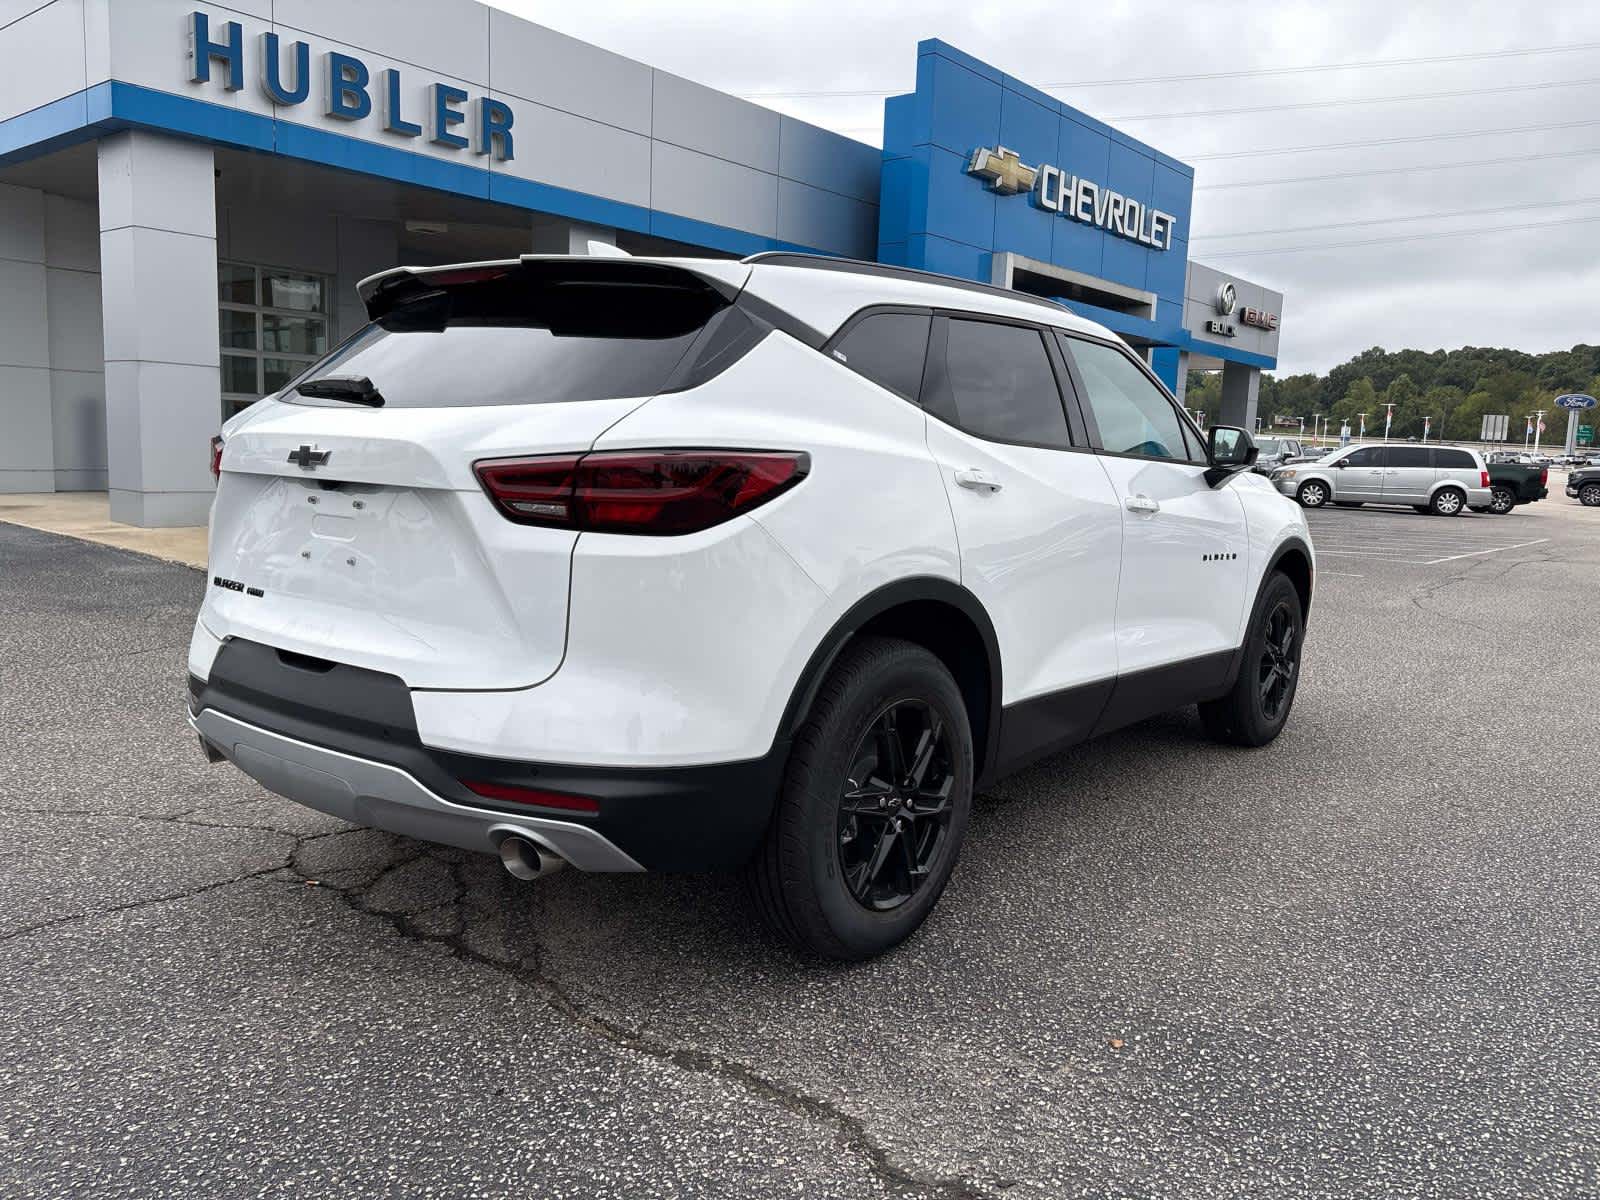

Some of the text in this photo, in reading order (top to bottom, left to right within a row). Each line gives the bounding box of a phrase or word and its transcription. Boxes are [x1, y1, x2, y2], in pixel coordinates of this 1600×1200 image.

[190, 11, 515, 162] HUBLER
[1038, 164, 1177, 250] CHEVROLET
[1209, 319, 1239, 337] BUICK
[1242, 306, 1278, 331] GMC
[1563, 397, 1589, 408] Ford
